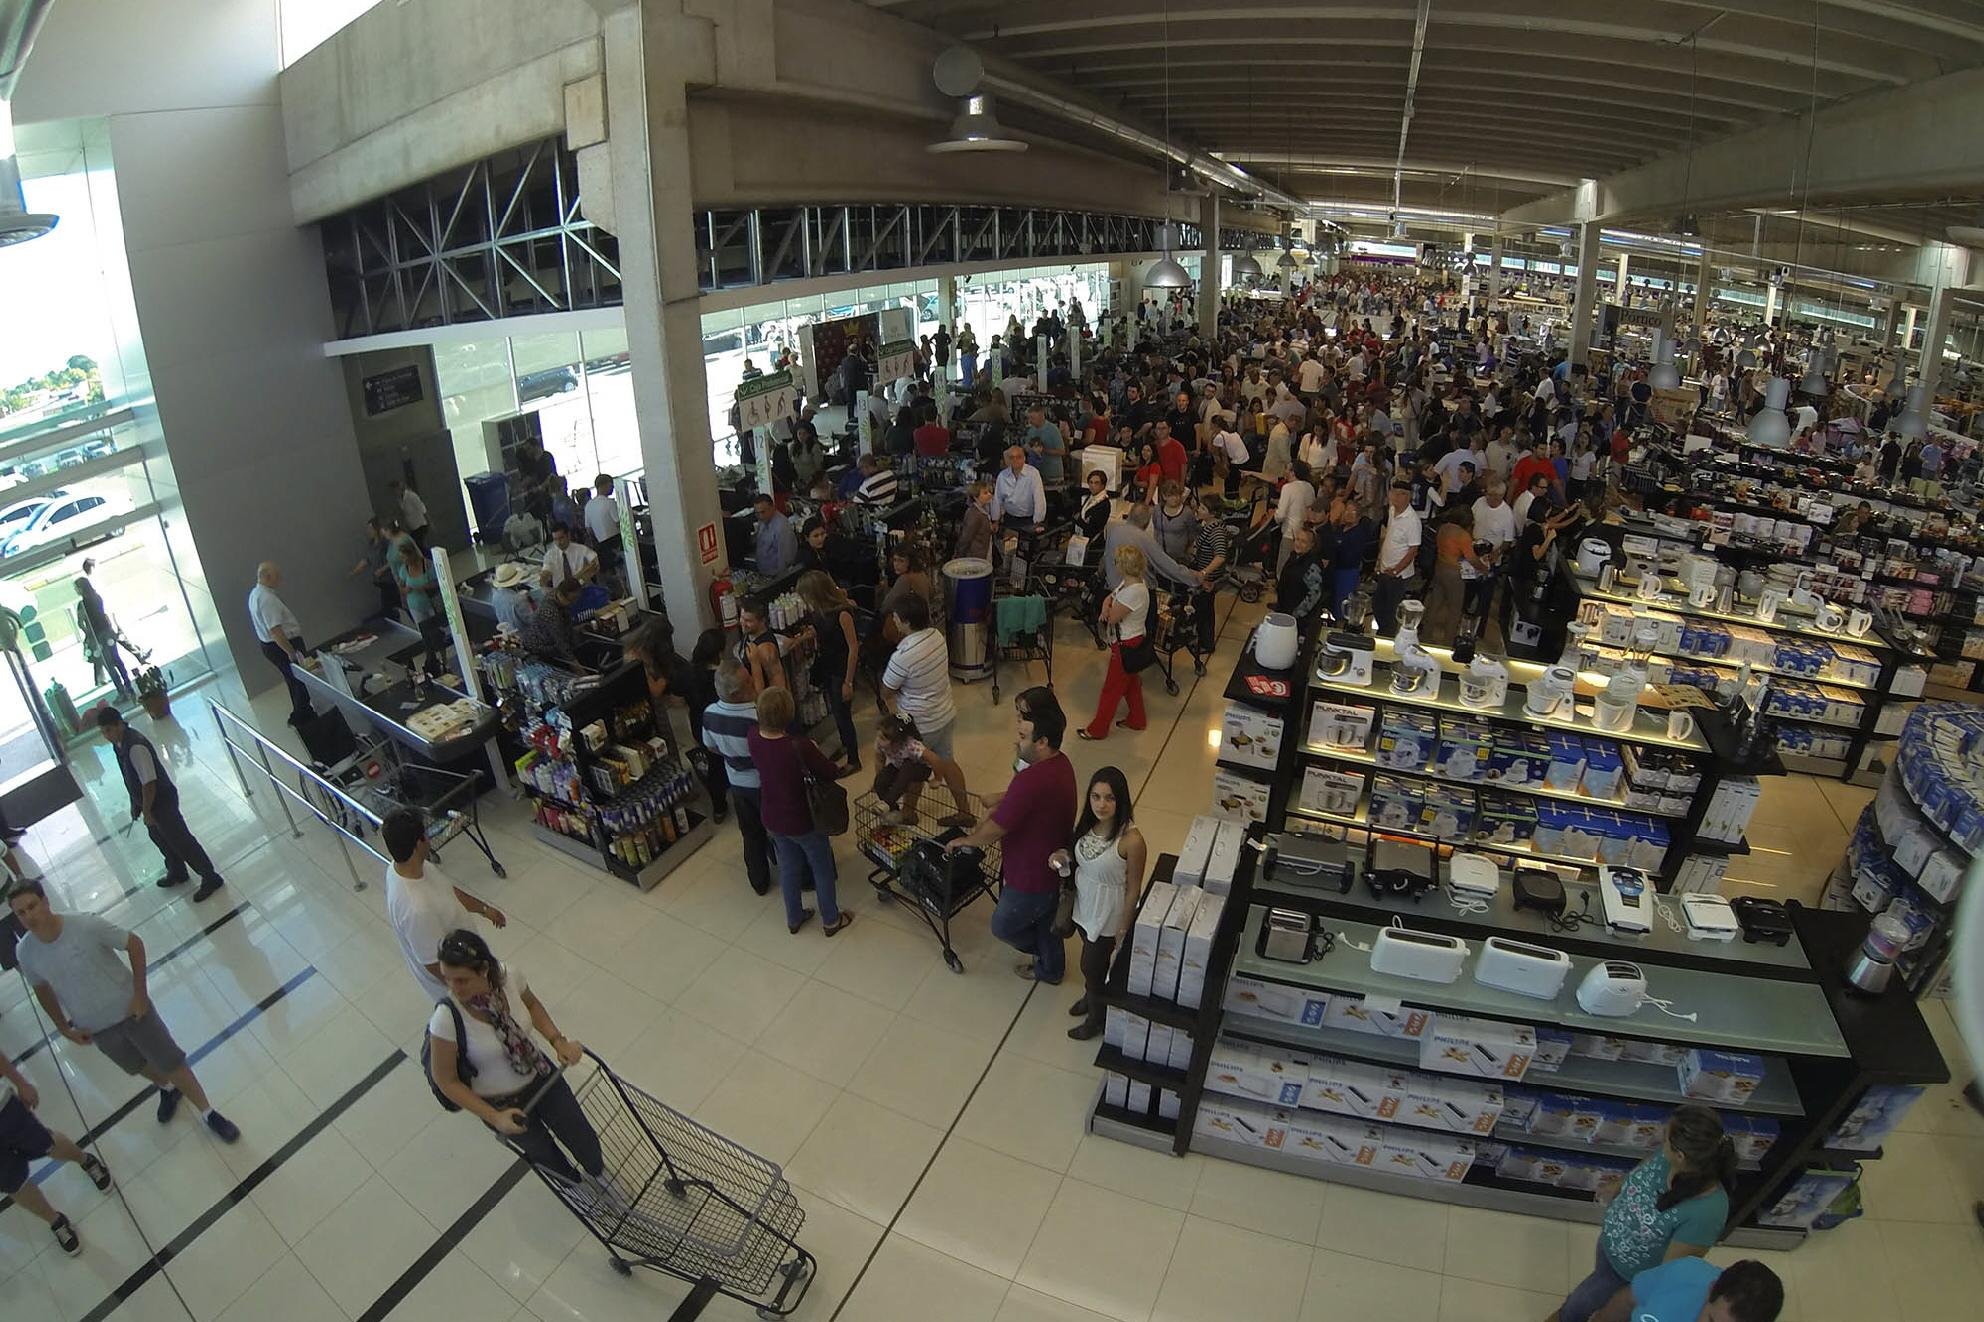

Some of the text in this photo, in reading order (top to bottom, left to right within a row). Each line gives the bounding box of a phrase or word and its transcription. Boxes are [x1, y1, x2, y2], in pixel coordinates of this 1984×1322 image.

[858, 400, 868, 412] 13
[754, 435, 764, 448] 12
[1316, 705, 1358, 716] PUNKTAL
[1434, 1036, 1470, 1046] PHILIPS
